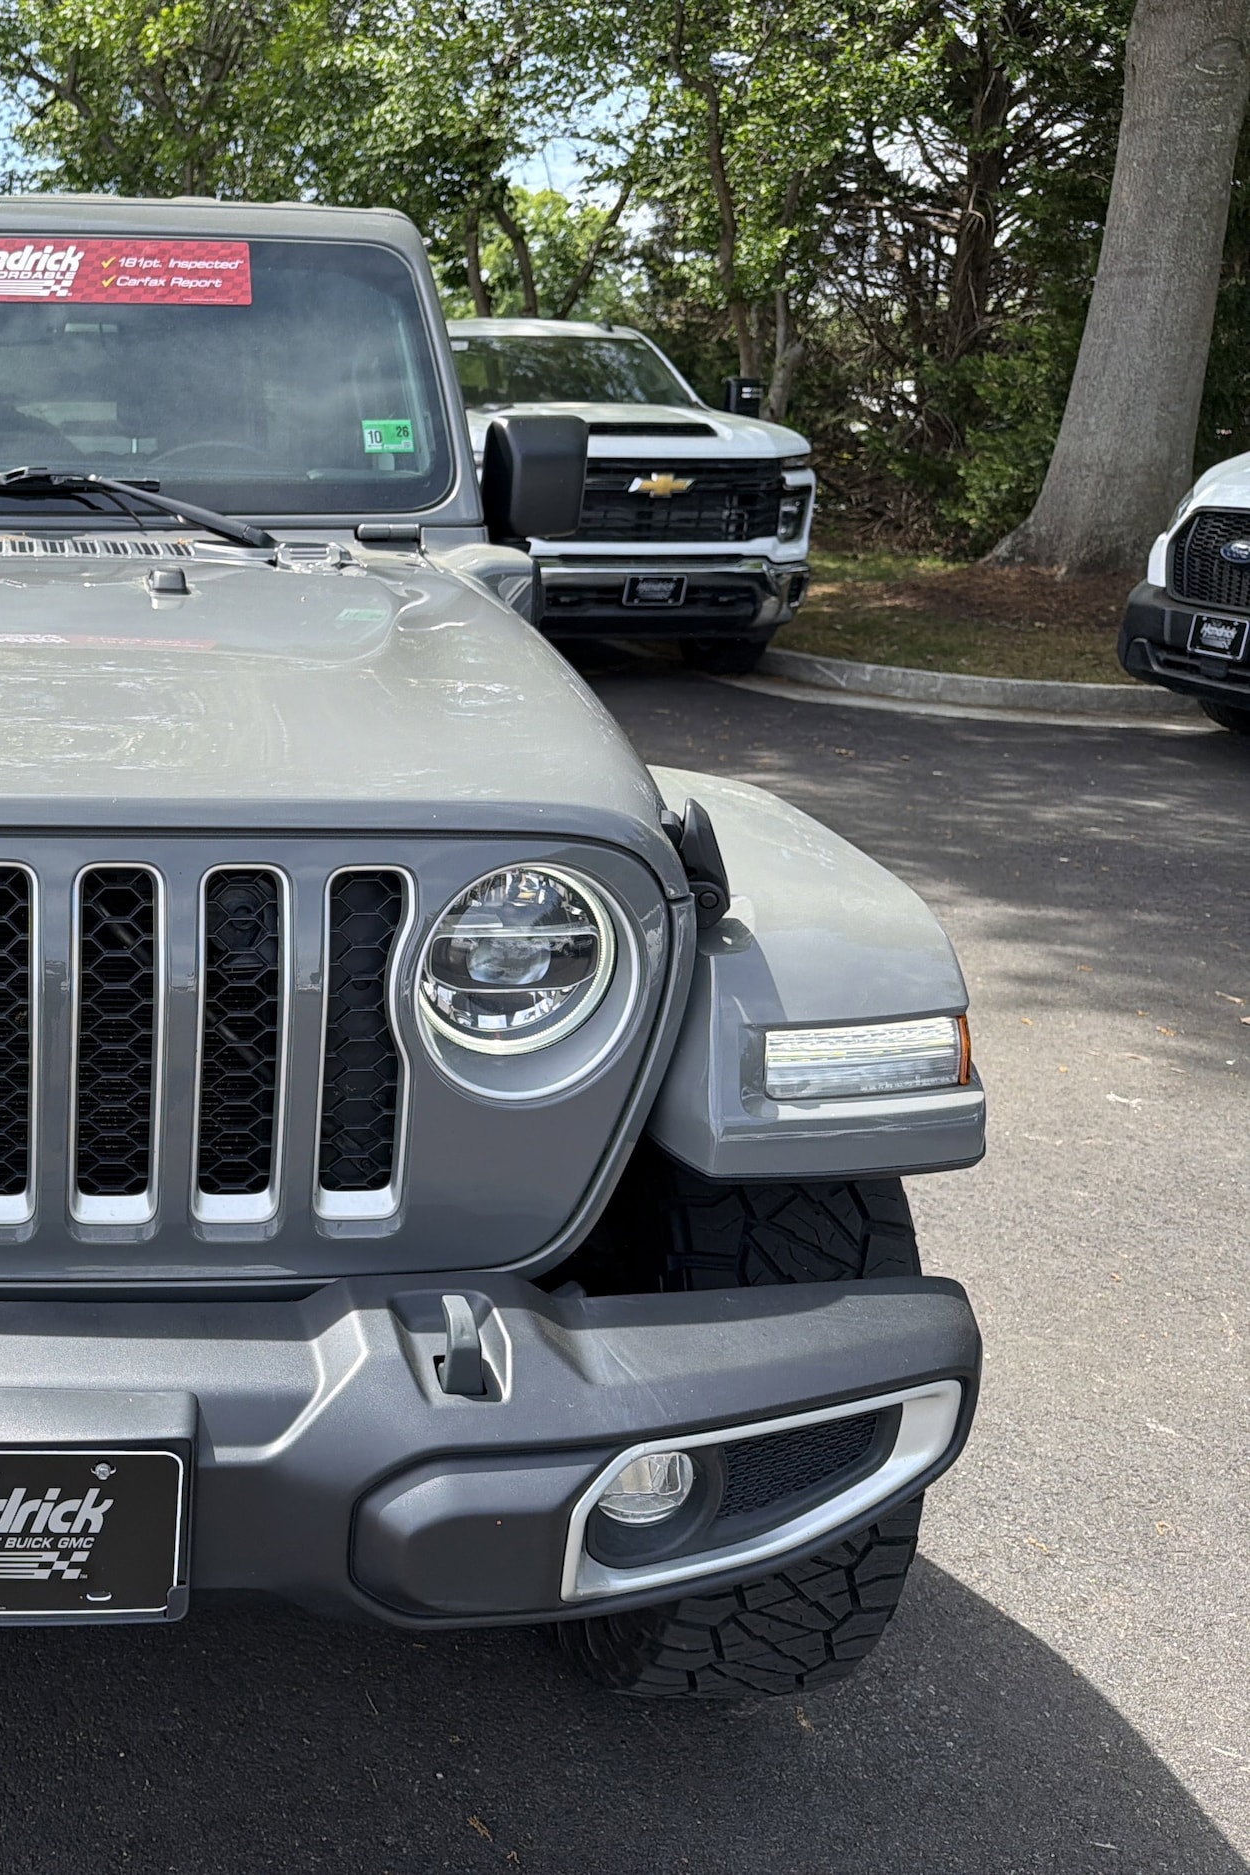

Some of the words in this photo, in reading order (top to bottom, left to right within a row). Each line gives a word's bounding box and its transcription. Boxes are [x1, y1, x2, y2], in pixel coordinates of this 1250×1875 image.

[116, 276, 166, 287] Carfax
[170, 277, 223, 289] Report
[367, 430, 383, 444] 10
[396, 425, 410, 438] 26
[4, 1536, 54, 1549] BUICK
[57, 1537, 95, 1549] GMC
